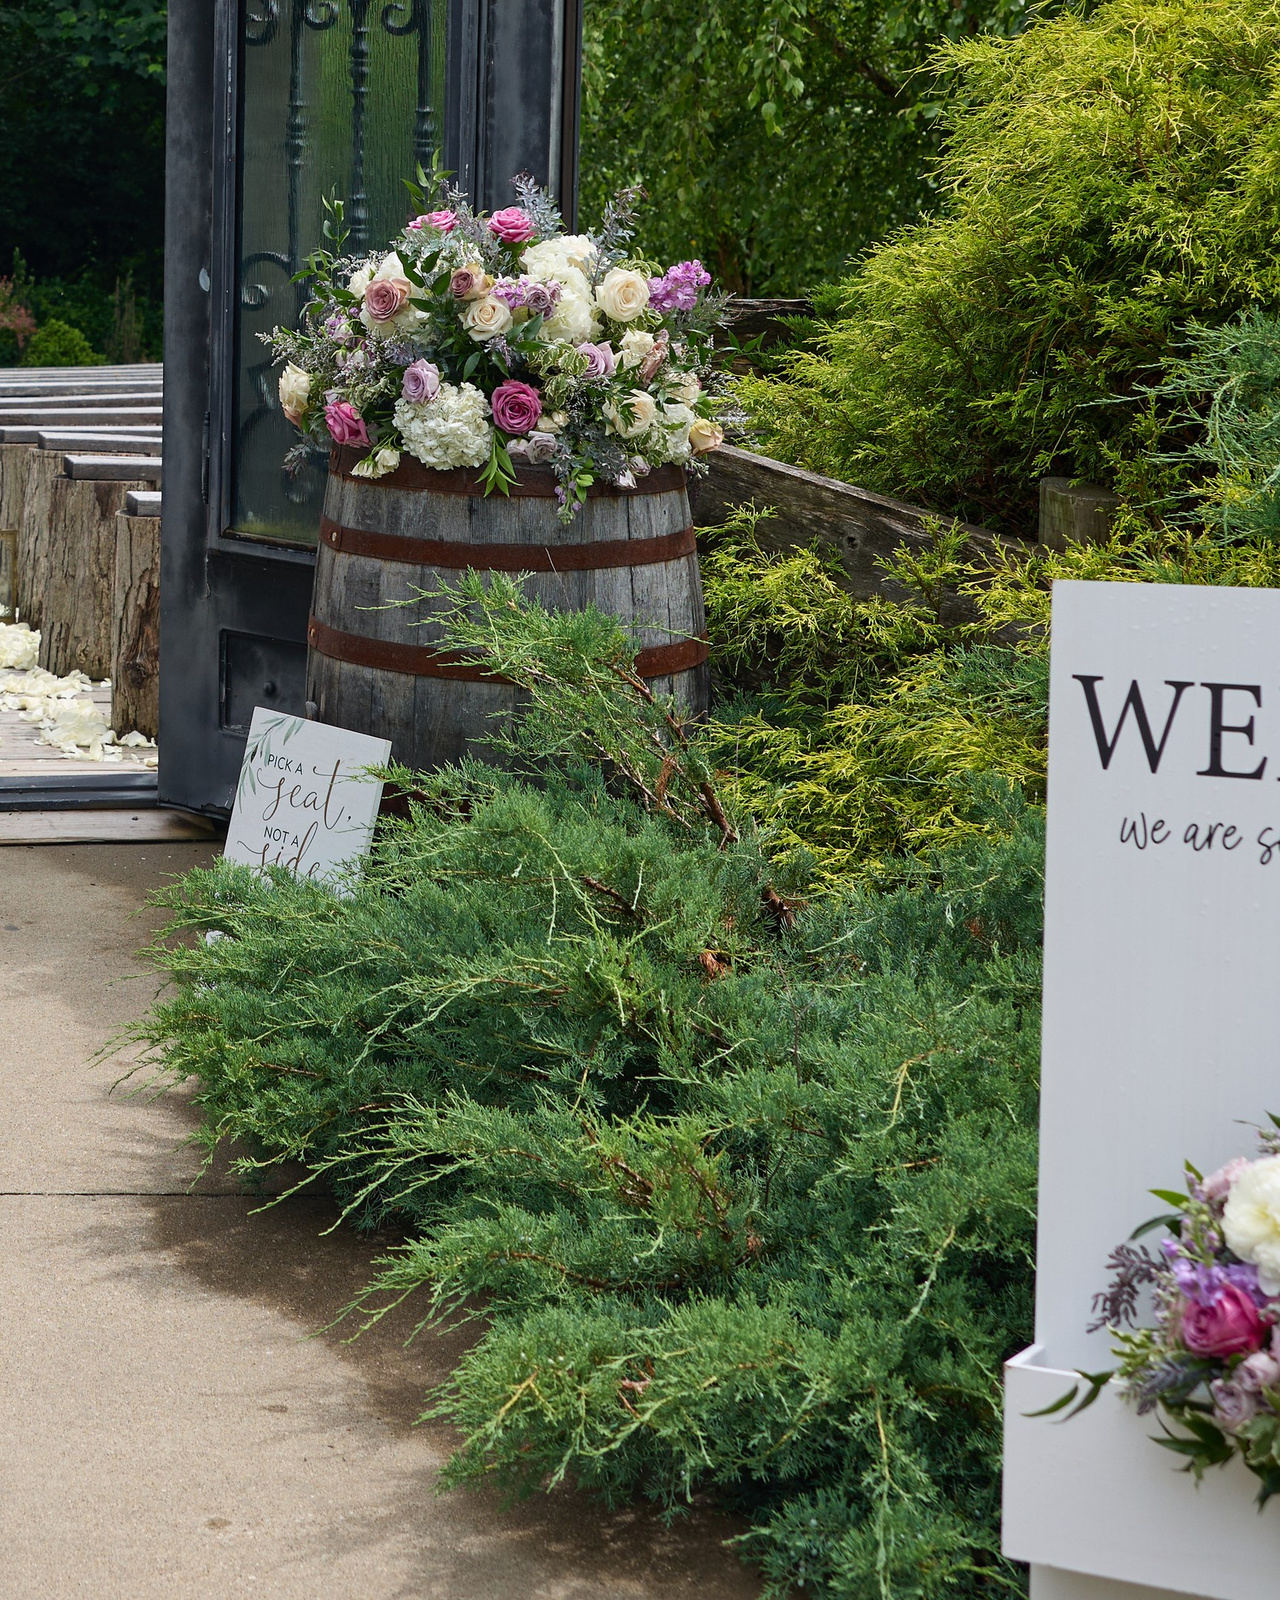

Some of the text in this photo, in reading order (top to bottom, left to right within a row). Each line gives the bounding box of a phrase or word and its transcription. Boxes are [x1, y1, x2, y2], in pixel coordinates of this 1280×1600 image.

[1072, 674, 1280, 782] WE
[267, 753, 304, 776] PICK A
[257, 759, 354, 830] seat,
[263, 825, 300, 848] NOT A
[1183, 822, 1243, 852] are
[1257, 827, 1280, 865] s
